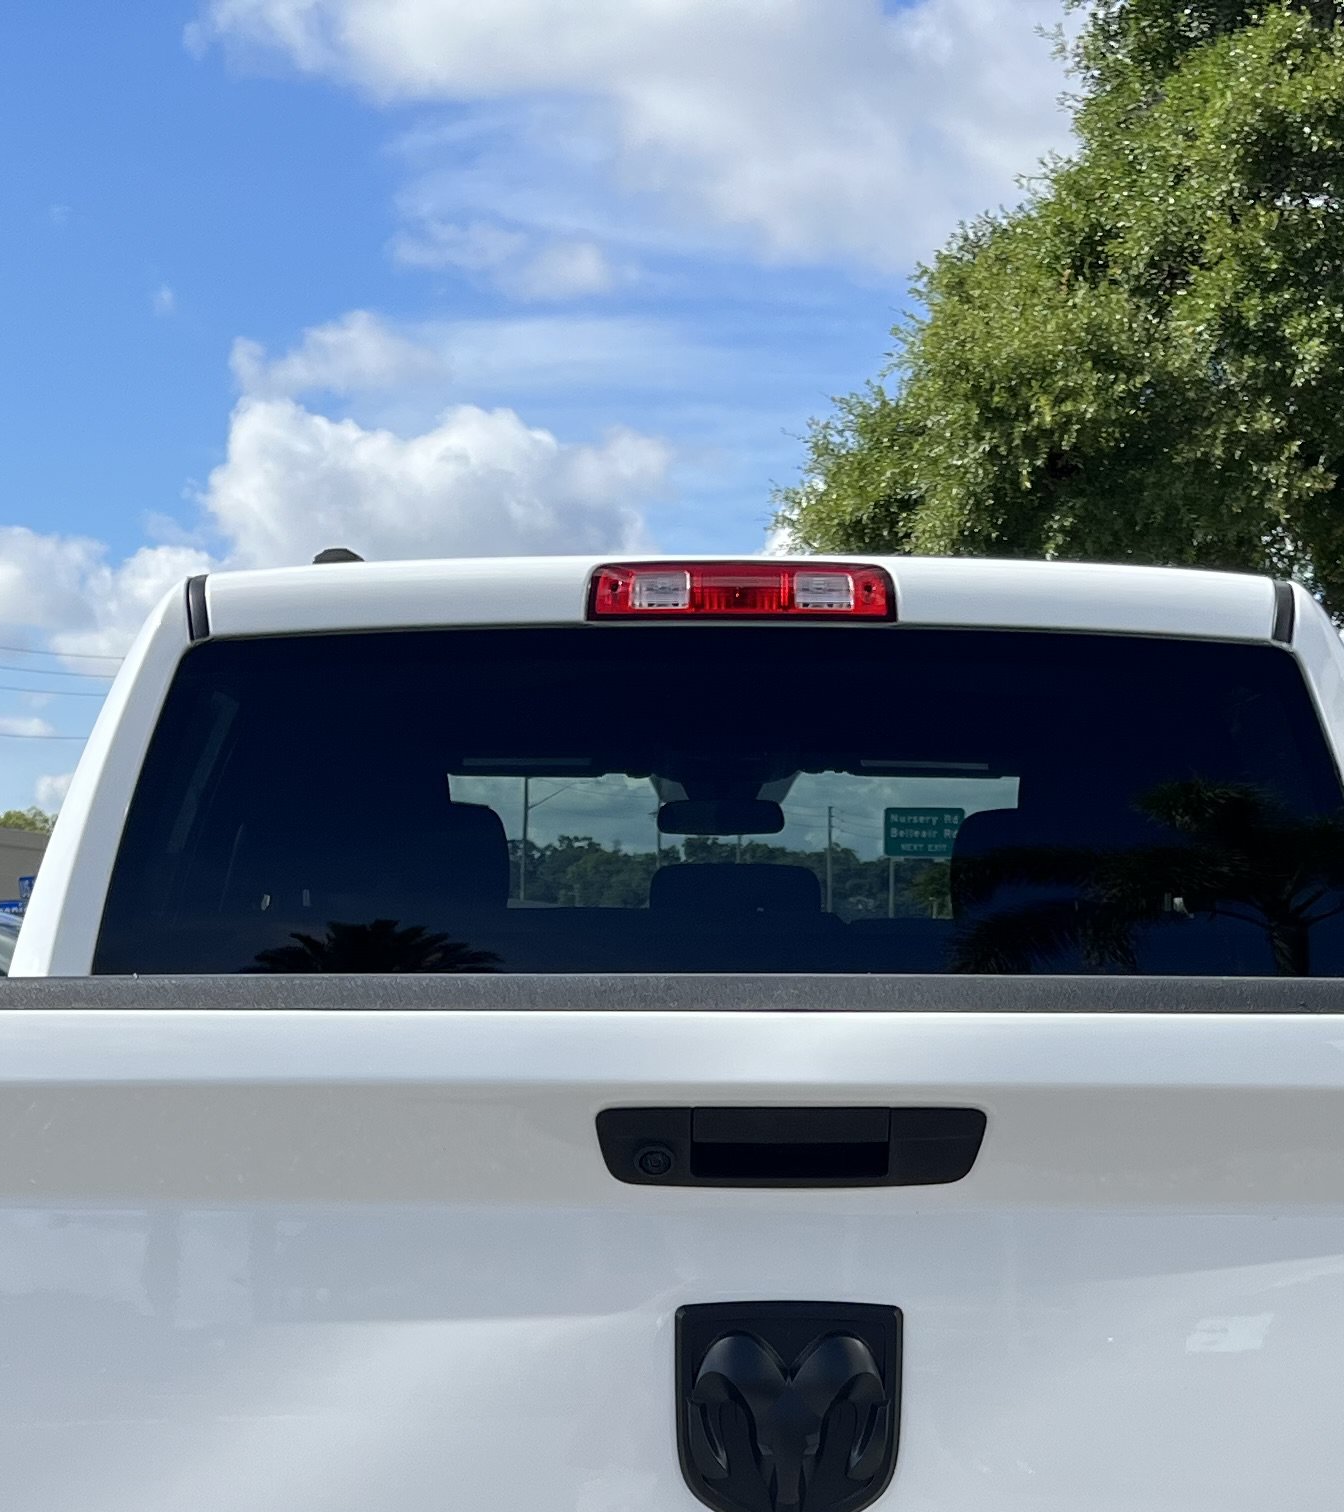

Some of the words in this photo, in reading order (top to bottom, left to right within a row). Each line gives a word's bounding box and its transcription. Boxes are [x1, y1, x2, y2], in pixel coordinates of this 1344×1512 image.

[890, 814, 938, 826] Nursery
[943, 814, 959, 825] Rd
[890, 827, 938, 838] Belleair
